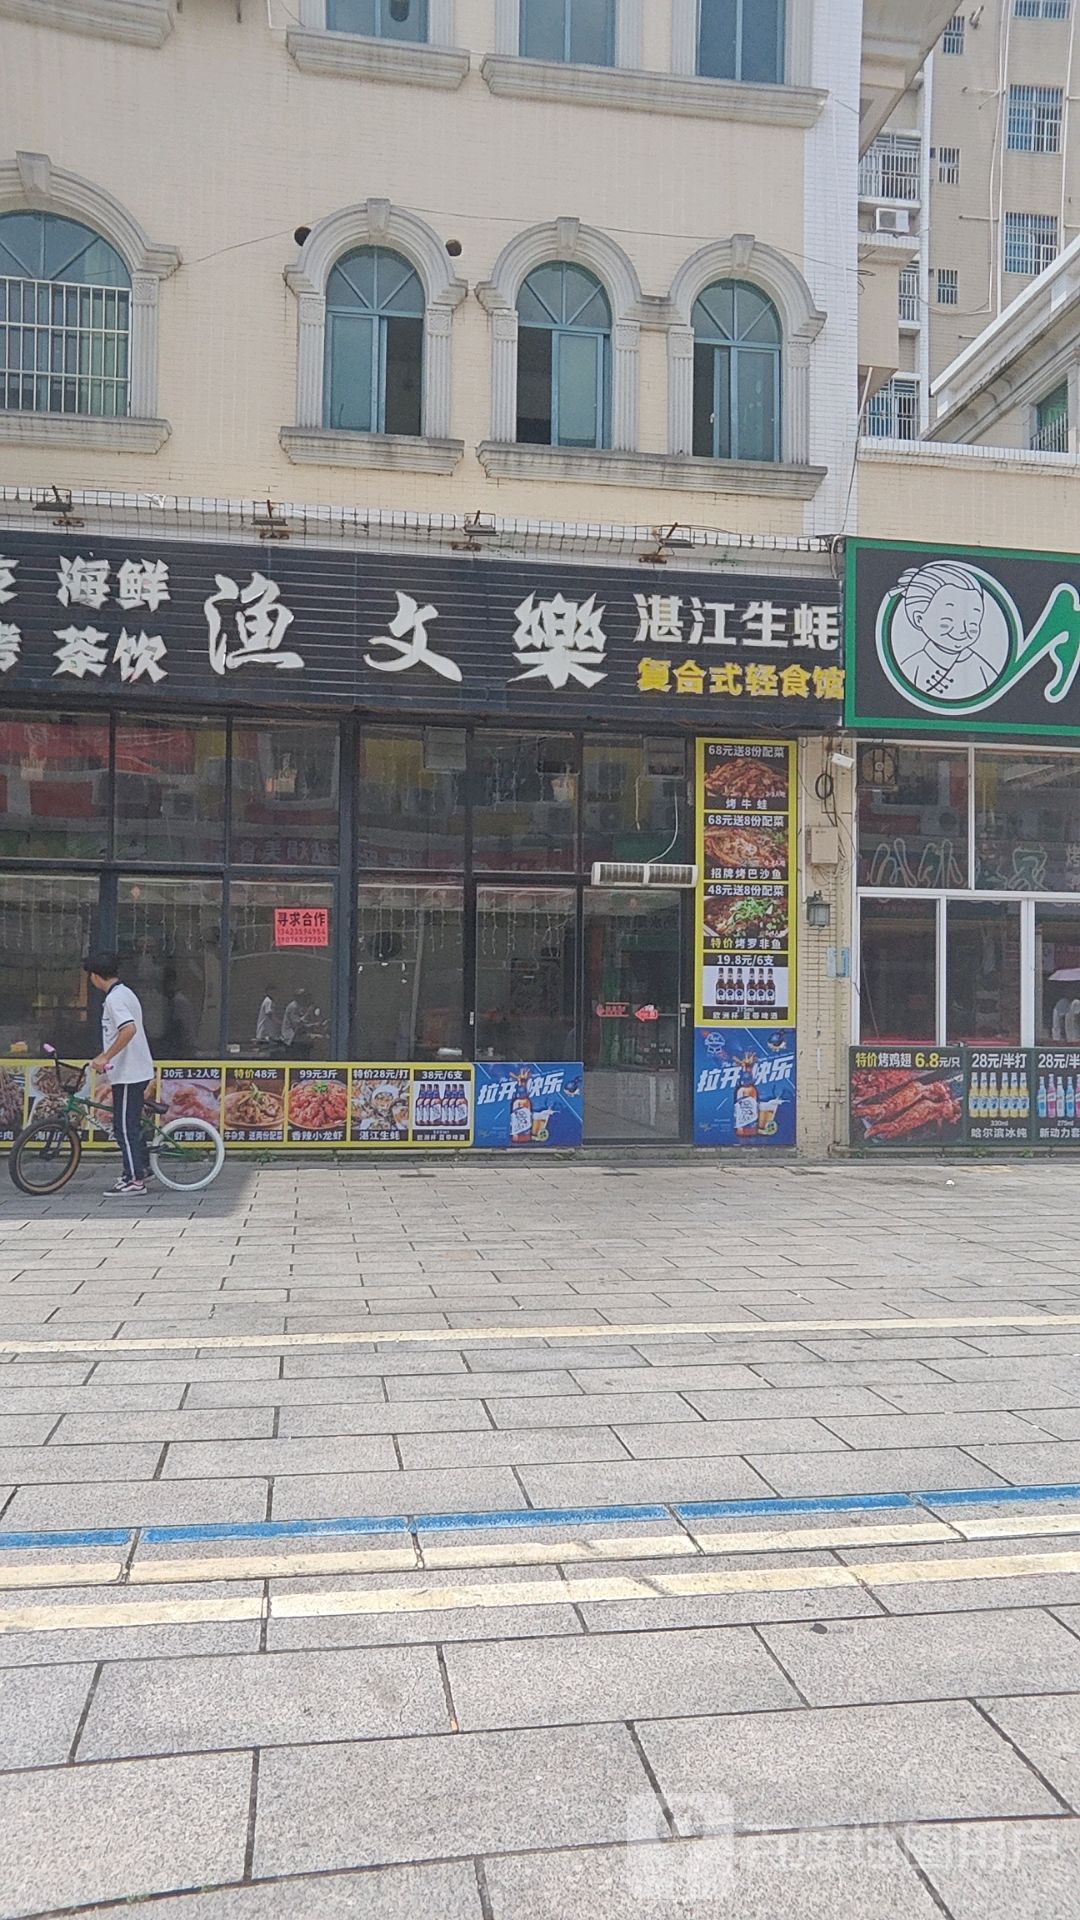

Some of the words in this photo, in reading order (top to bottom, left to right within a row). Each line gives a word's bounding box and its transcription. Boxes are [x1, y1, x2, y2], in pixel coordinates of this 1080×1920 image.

[56, 552, 171, 612] 海鲜
[633, 593, 840, 650] 湛江生蚝
[52, 625, 168, 684] 茶饮
[636, 657, 845, 700] 复合式轻食馆
[708, 745, 785, 758] 68元送8份配菜
[725, 798, 768, 810] 烤牛蛙
[708, 815, 784, 827] 68元送8份配菜
[710, 868, 782, 879] 招牌烤巴沙鱼
[708, 884, 784, 896] 48元送8份配菜
[277, 912, 326, 927] 寻求合作
[710, 938, 781, 949] 特价烤罗非鱼
[717, 955, 774, 966] 19.8元/6支
[855, 1053, 911, 1067] 特价烤鸡翅
[915, 1052, 960, 1068] 6.8元/只
[971, 1053, 1027, 1068] 28元/半打
[163, 1069, 184, 1079] 30元
[187, 1069, 220, 1079] 1-2人吃
[234, 1069, 278, 1079] 特价48元
[299, 1069, 338, 1079] 99元3斤
[352, 1069, 409, 1079] 特价28元/打
[422, 1070, 463, 1081] 38元/6支
[291, 1131, 343, 1141] 香辣小龙虾
